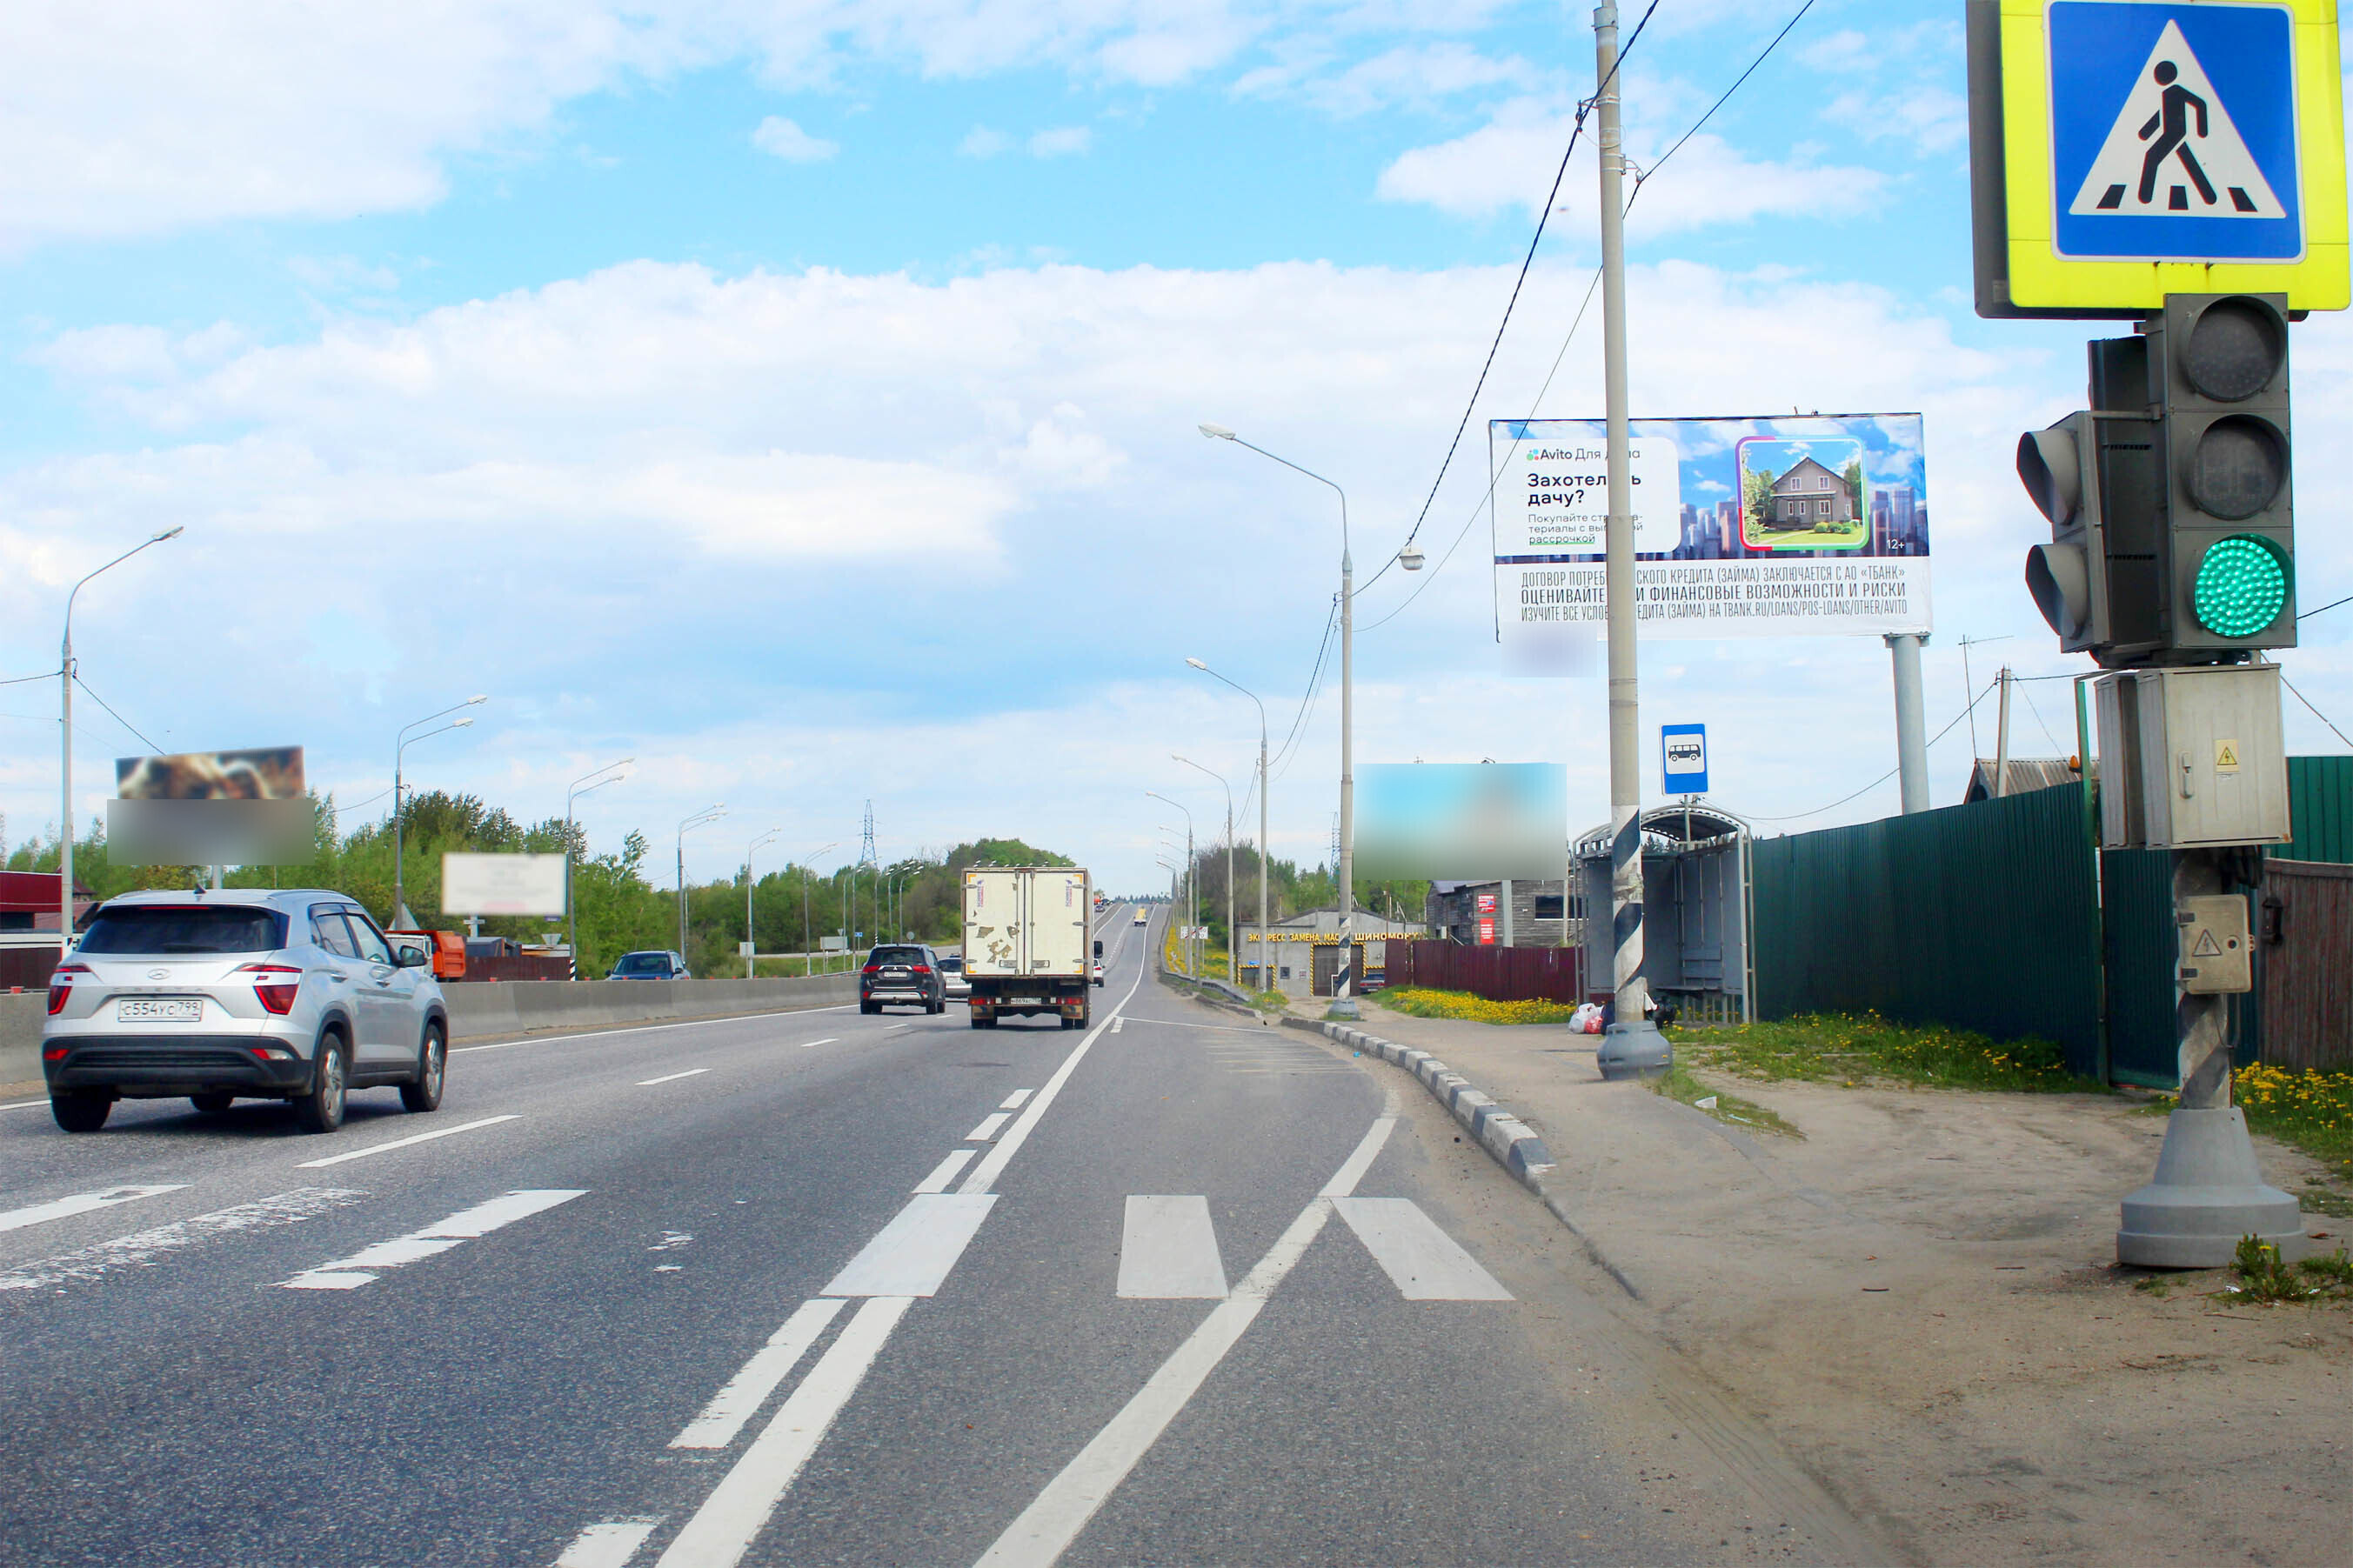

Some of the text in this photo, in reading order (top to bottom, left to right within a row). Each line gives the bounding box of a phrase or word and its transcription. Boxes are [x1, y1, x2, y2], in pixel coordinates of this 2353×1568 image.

[1541, 449, 1572, 459] Avito
[1575, 448, 1601, 462] Для
[1527, 473, 1641, 487] Захотель
[1528, 490, 1585, 508] дачу?
[1528, 513, 1588, 524] Покупайте
[1528, 524, 1576, 535] териалы
[1529, 534, 1595, 545] рассрочкой
[1886, 538, 1905, 550] 12+
[1521, 571, 1567, 588] ДОГОВОР
[1670, 568, 1714, 584] КРЕДИТА
[1717, 565, 1760, 584] (ЗАЙМА)
[1763, 566, 1832, 583] ЗАКЛЮЧАЕТСЯ
[1835, 566, 1842, 581] С
[1845, 565, 1857, 581] АО
[1861, 565, 1905, 580] «ТБАНК»
[1521, 586, 1605, 605] ОЦЕНИВАЙТЕ
[1649, 584, 1741, 602] ФИНАНСОВЫЕ
[1747, 583, 1843, 600] ВОЗМОЖНОСТИ
[1849, 583, 1857, 597] И
[1863, 582, 1906, 597] РИСКИ
[1521, 606, 1560, 622] ИЗУЧИТЕ
[1563, 605, 1579, 621] ВСЕ
[1668, 601, 1706, 619] (ЗАЙМА)
[1709, 603, 1721, 617] НА
[1724, 599, 1908, 617] TBANK.RU/LOANS/POS-LOANS/OTHER/AVITO
[1289, 933, 1320, 942] ЗАМЕНА
[177, 1002, 198, 1011] 799
